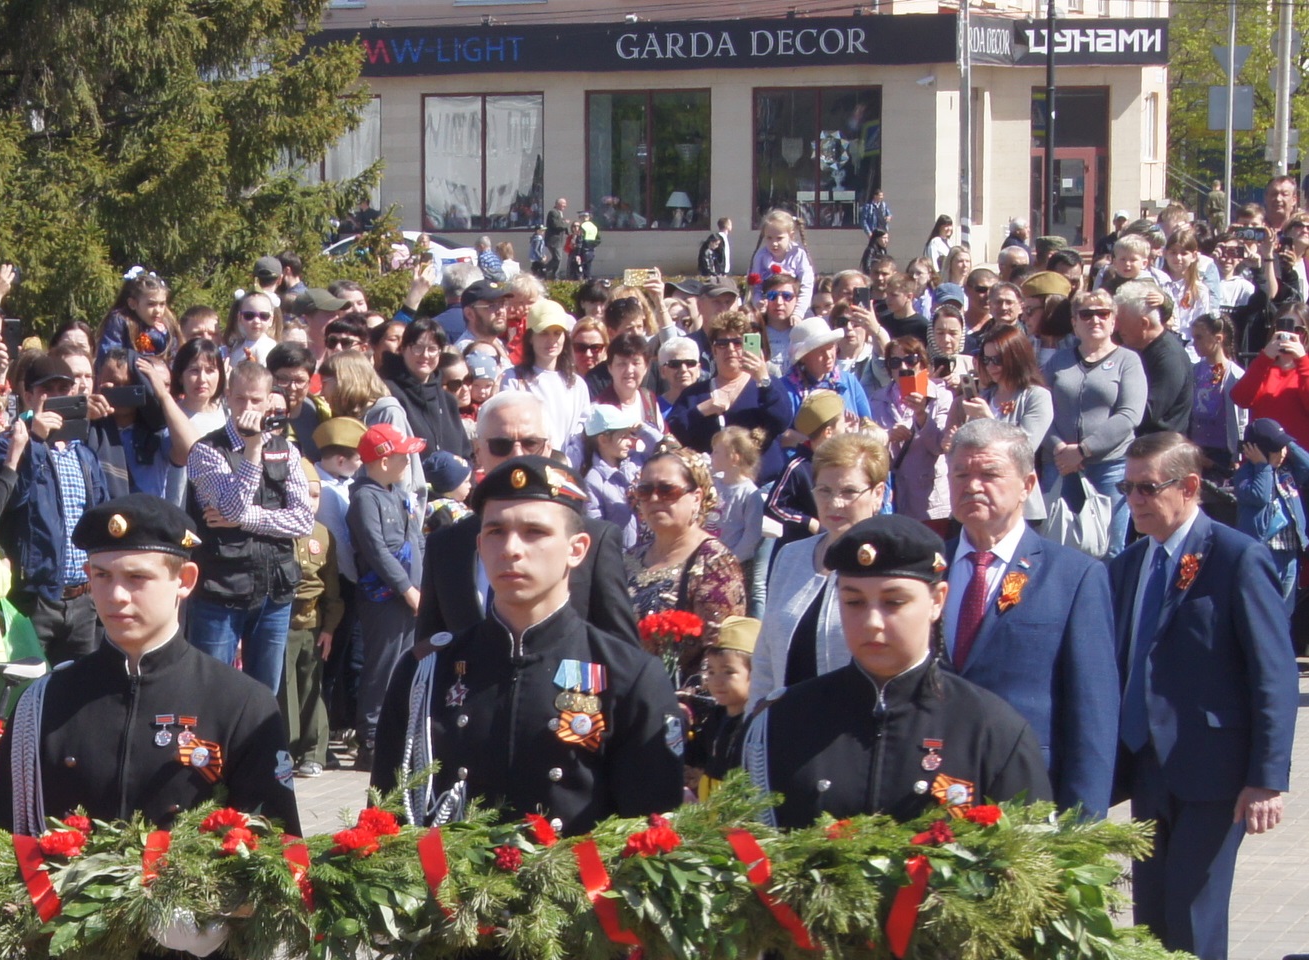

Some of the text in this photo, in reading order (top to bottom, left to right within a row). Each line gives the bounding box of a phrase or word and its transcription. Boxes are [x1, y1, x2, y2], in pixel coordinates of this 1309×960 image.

[616, 28, 869, 60] GARDA DECOR
[986, 28, 1011, 56] DECOR
